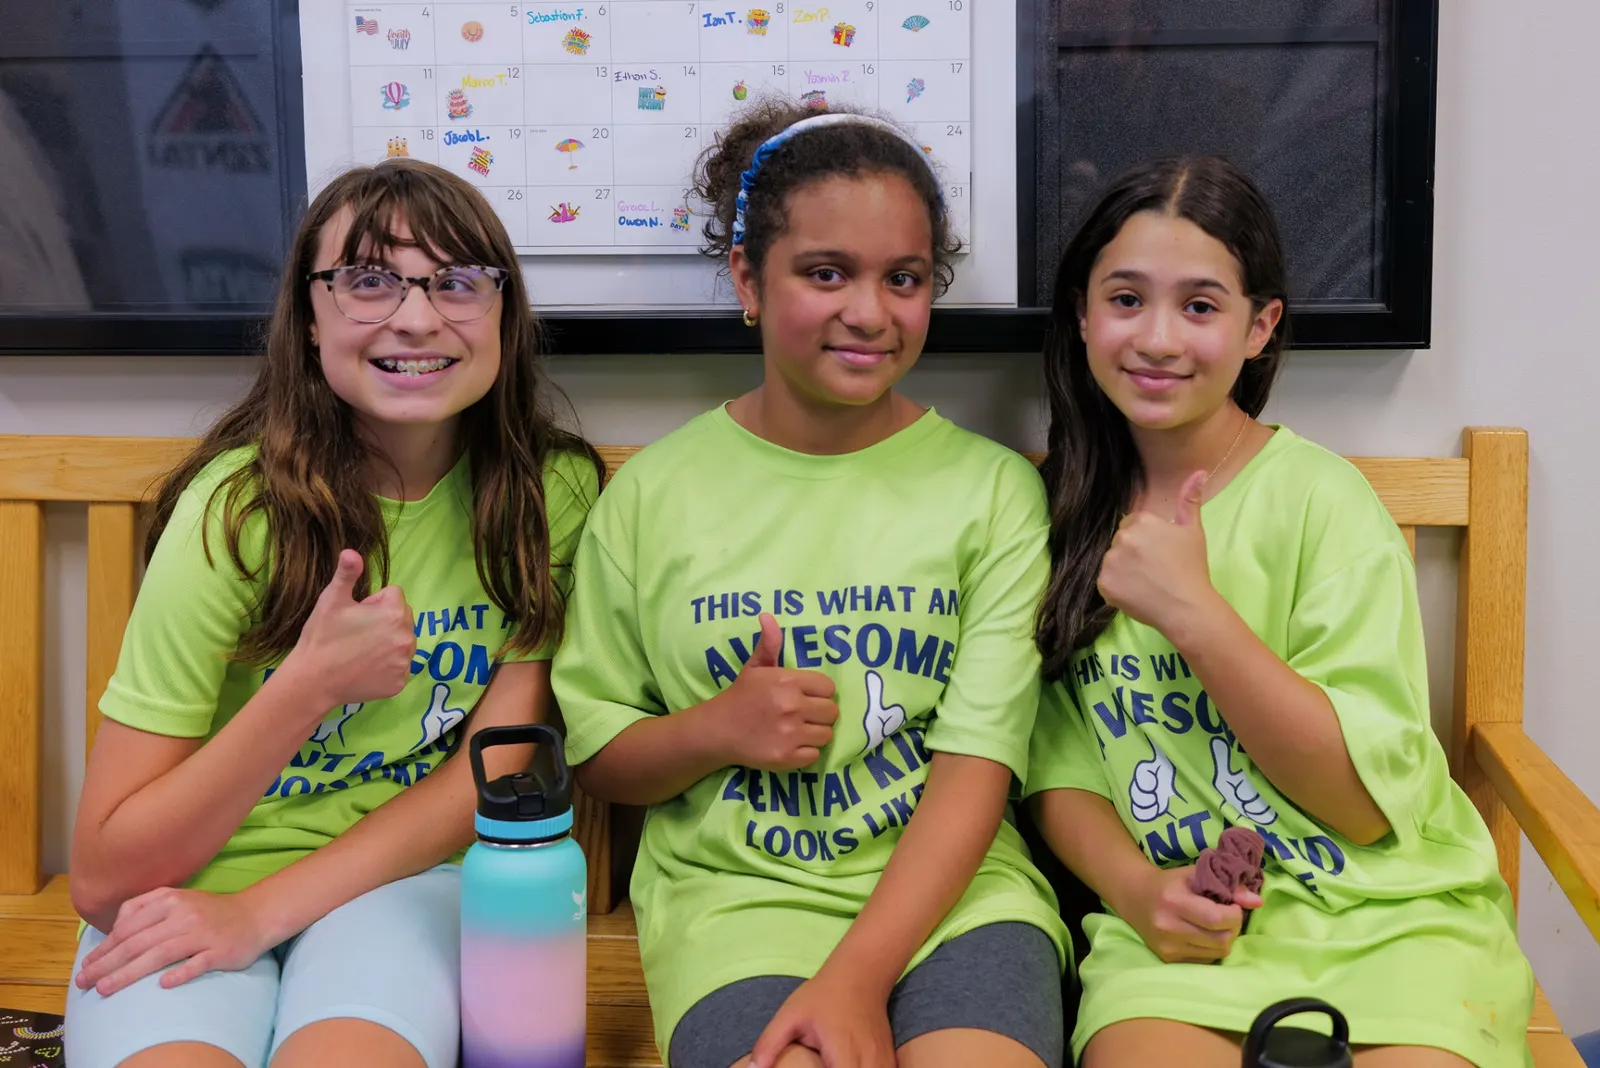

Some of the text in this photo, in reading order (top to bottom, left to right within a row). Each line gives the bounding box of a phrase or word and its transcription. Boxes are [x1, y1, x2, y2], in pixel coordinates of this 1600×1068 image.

[598, 5, 606, 16] 6
[688, 4, 695, 14] 7
[776, 2, 784, 14] 8
[866, 2, 874, 12] 9
[949, 0, 963, 11] 10
[422, 7, 430, 17] 4
[510, 6, 518, 17] 5
[702, 13, 726, 28] Ian
[725, 12, 742, 24] T.
[507, 68, 520, 78] 12
[596, 66, 608, 78] 13
[684, 66, 696, 76] 14
[772, 65, 785, 76] 15
[862, 64, 874, 74] 16
[951, 62, 963, 74] 17
[424, 69, 432, 80] 11
[650, 70, 662, 80] S.
[421, 130, 434, 140] 18
[476, 130, 490, 142] L.
[509, 128, 521, 139] 19
[592, 128, 609, 138] 20
[684, 127, 697, 138] 21
[946, 125, 962, 136] 24
[508, 190, 522, 200] 26
[595, 188, 610, 200] 27
[950, 186, 963, 198] 31
[649, 216, 663, 228] N.
[691, 592, 762, 624] THIS
[774, 589, 804, 616] IS
[816, 586, 916, 616] WHAT
[1111, 654, 1141, 681] IS
[746, 819, 859, 862] LOOKS
